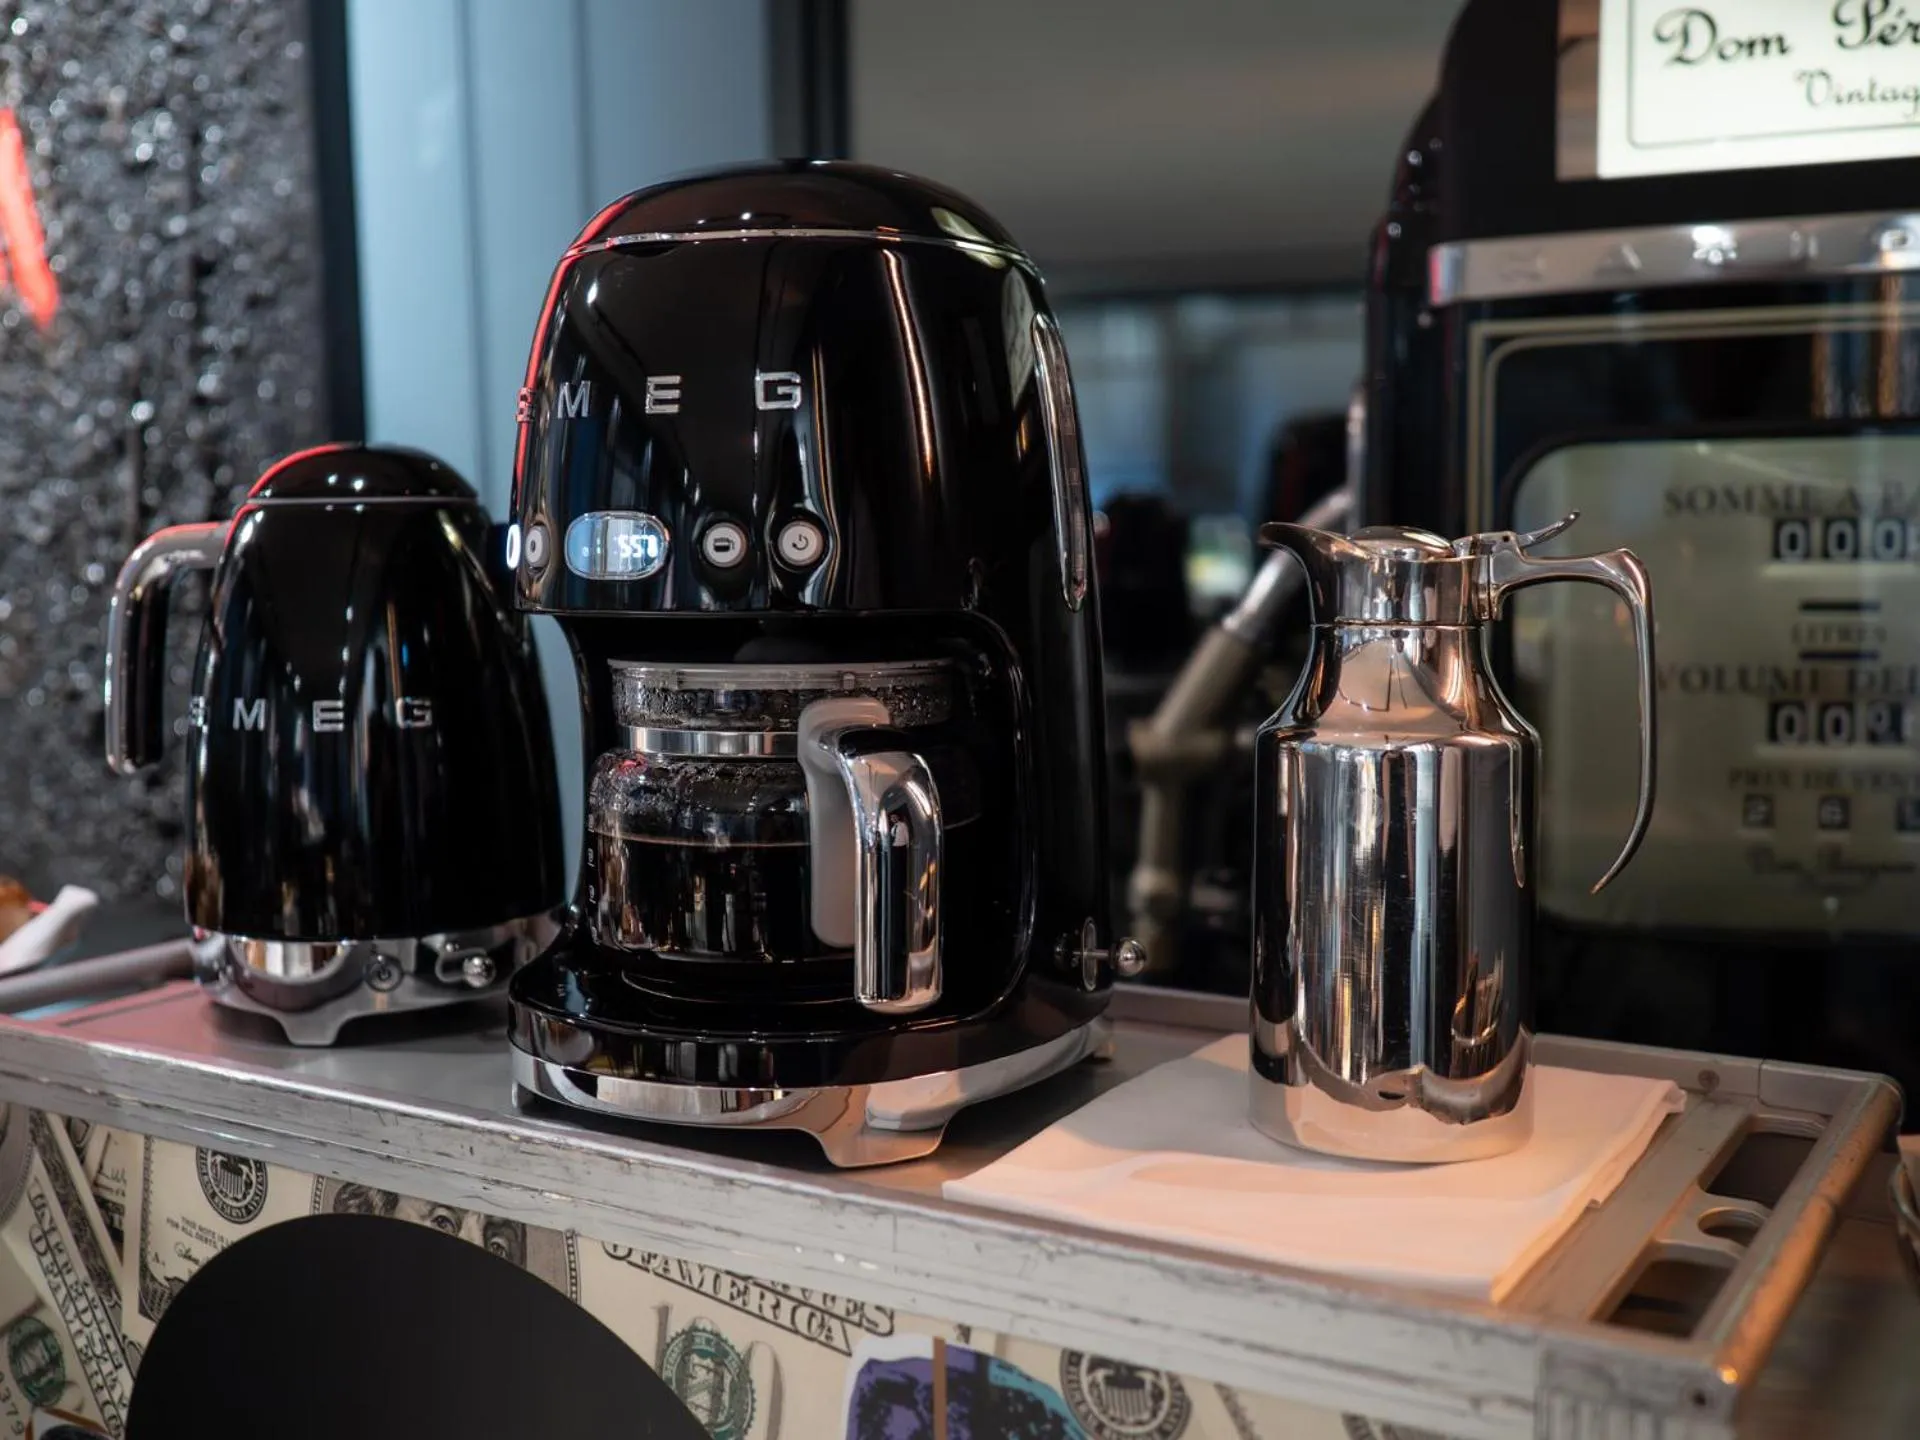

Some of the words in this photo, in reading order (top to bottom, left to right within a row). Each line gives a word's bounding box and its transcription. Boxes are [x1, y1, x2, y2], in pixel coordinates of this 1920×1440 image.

[1653, 8, 1792, 66] Dom
[516, 371, 802, 422] SMEG
[189, 696, 433, 732] SMEG
